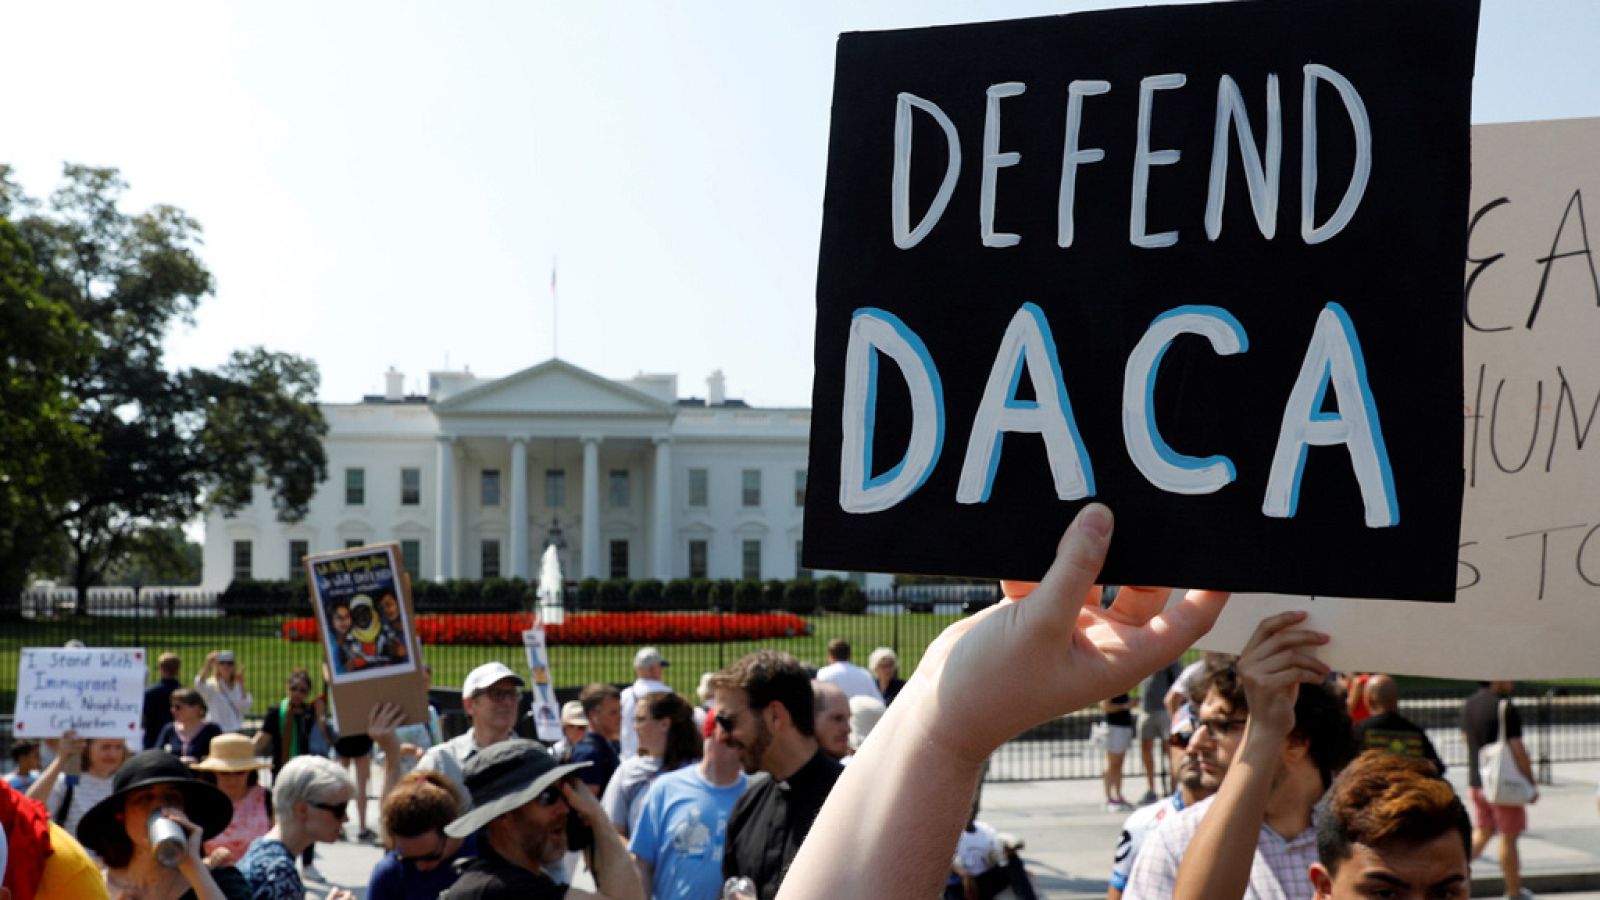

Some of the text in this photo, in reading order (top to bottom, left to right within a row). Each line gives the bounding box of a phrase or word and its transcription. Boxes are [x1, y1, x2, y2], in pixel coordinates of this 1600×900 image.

[892, 62, 1373, 250] DEFEND
[839, 301, 1401, 529] DACA
[27, 651, 133, 669] I Stand With
[33, 670, 118, 696] Immigrant
